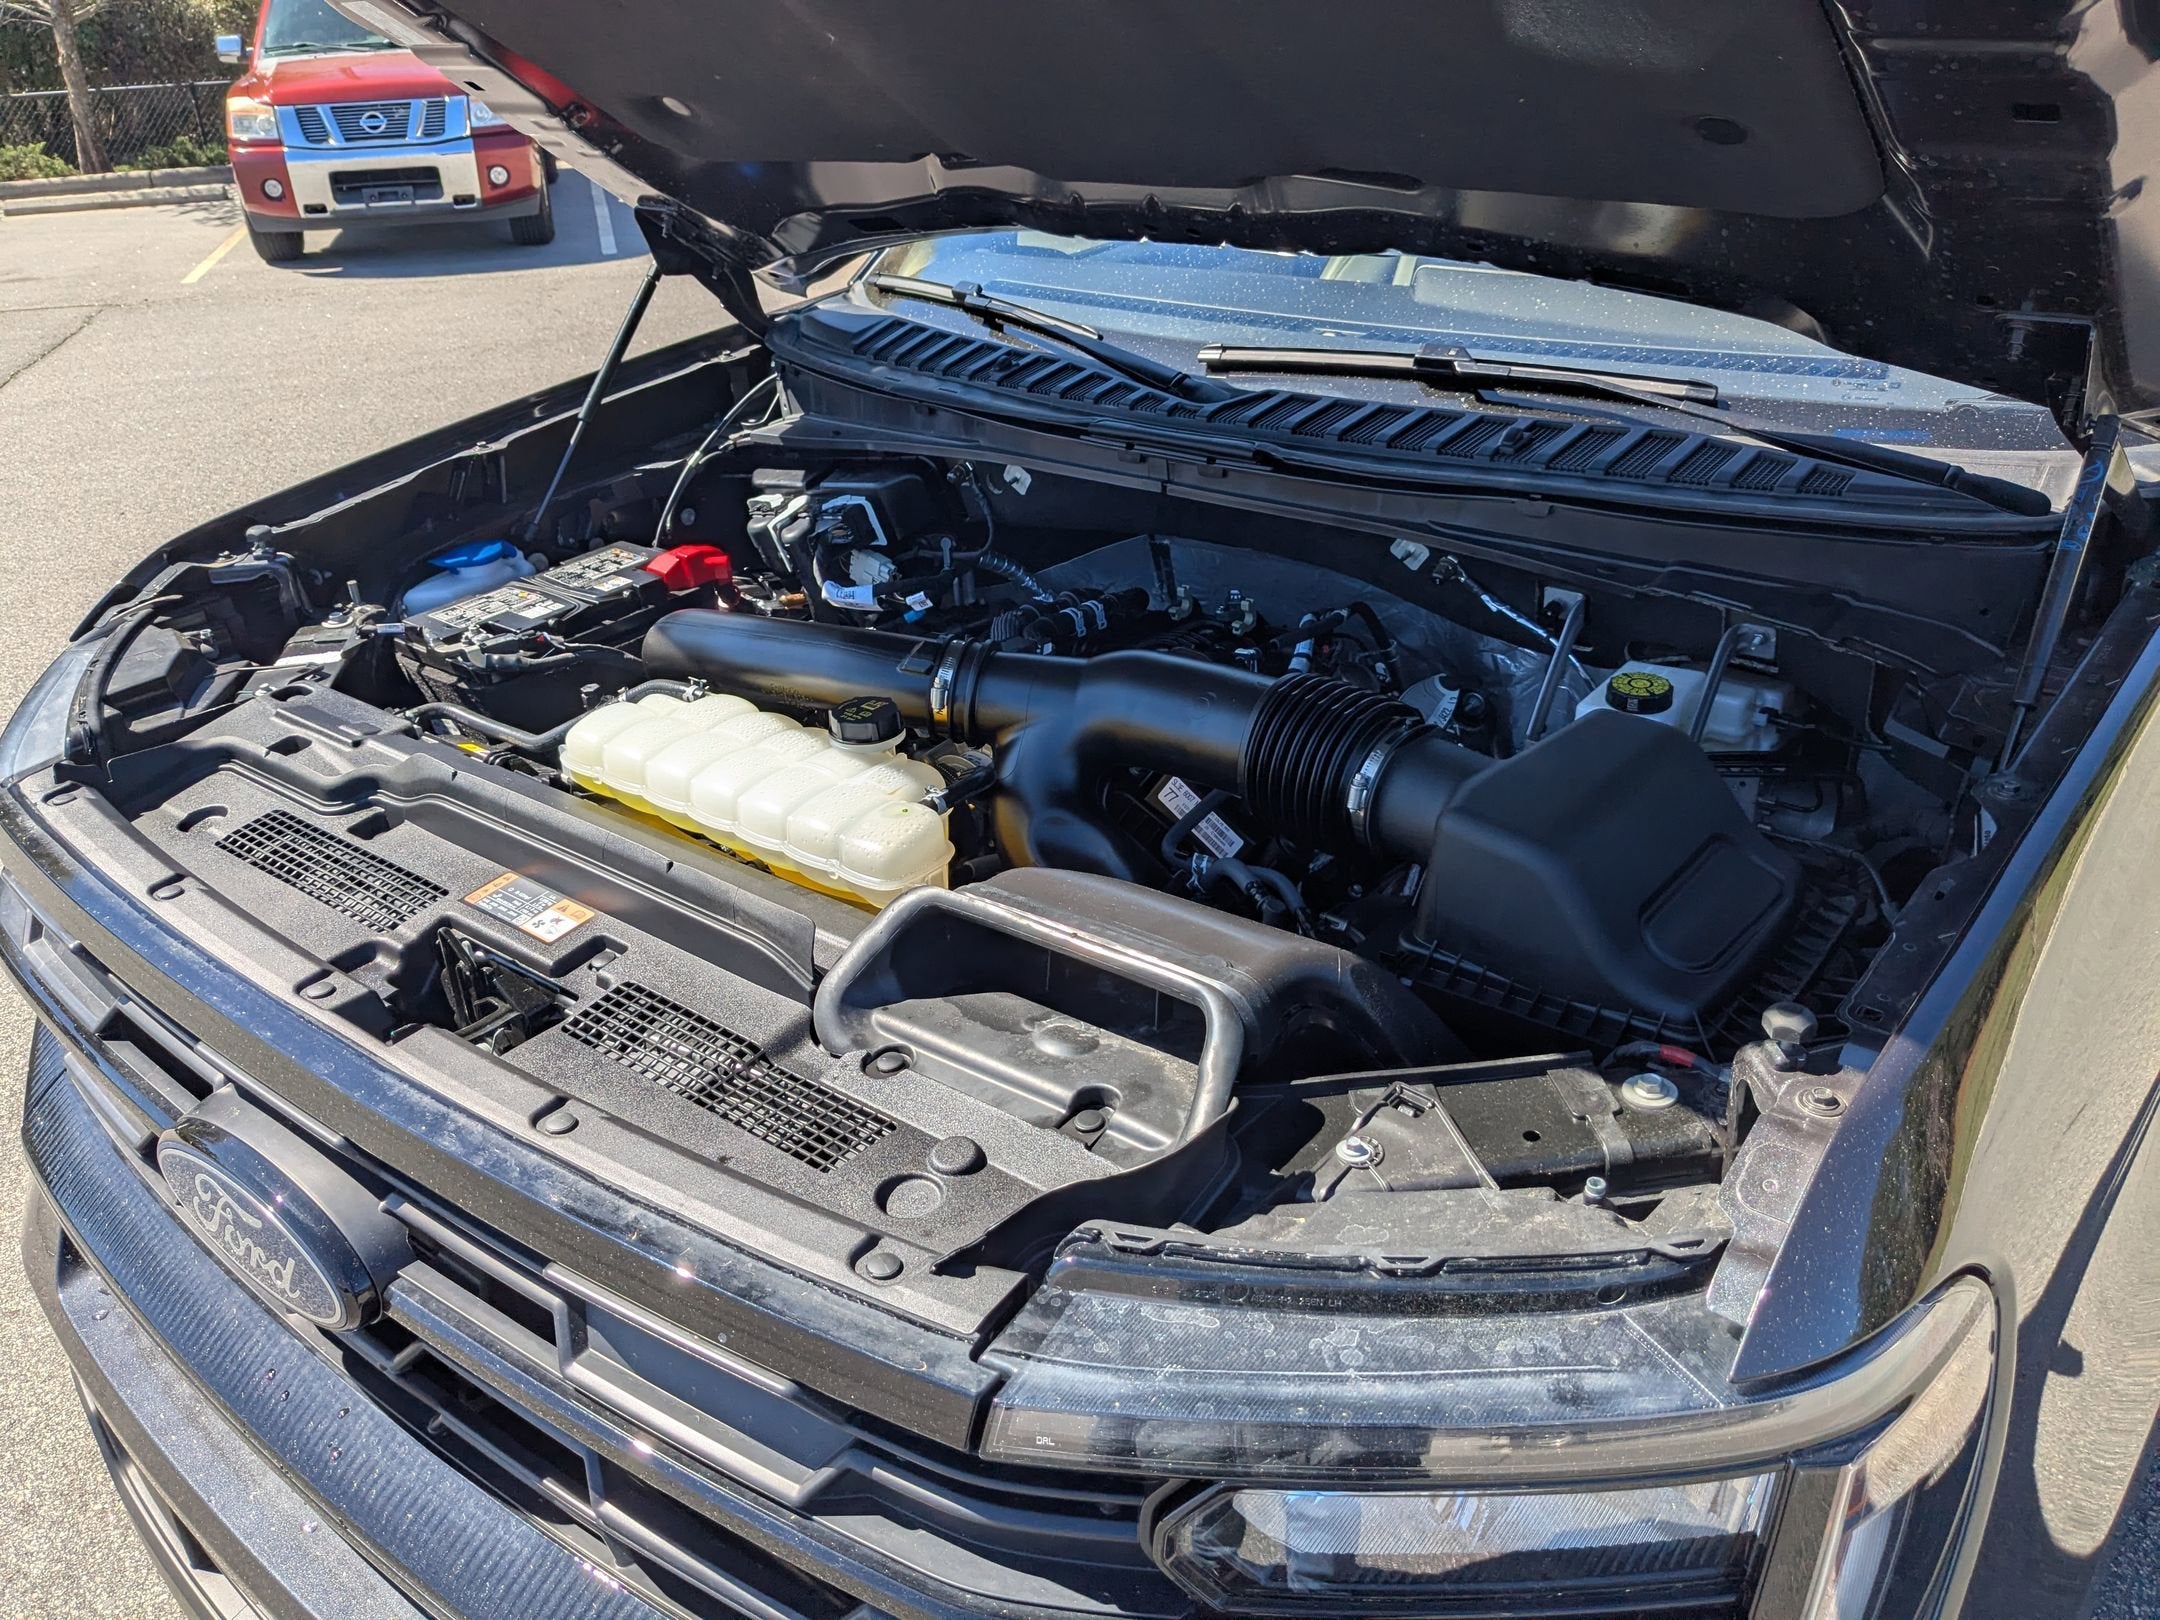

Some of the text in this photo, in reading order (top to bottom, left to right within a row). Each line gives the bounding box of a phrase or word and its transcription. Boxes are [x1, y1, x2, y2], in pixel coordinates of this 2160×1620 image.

[1163, 786, 1180, 802] 77
[192, 1172, 302, 1300] Ford
[1036, 1436, 1055, 1446] DRL
